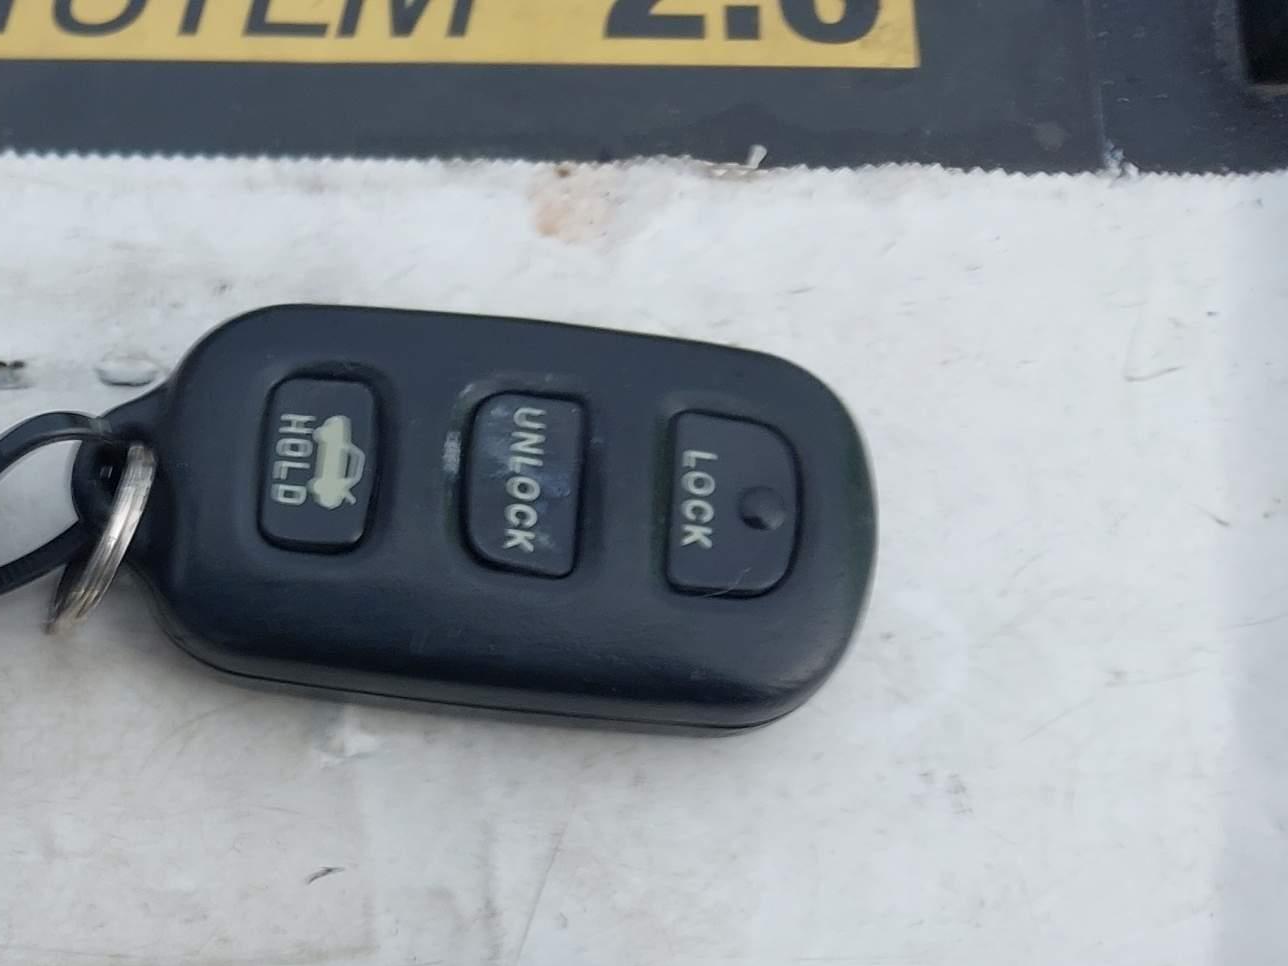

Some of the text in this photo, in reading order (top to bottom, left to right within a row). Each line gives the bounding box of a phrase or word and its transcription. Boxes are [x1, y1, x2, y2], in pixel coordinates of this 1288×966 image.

[271, 412, 314, 506] HOLD
[504, 406, 546, 553] UNLOCK
[681, 448, 718, 549] LOCK
